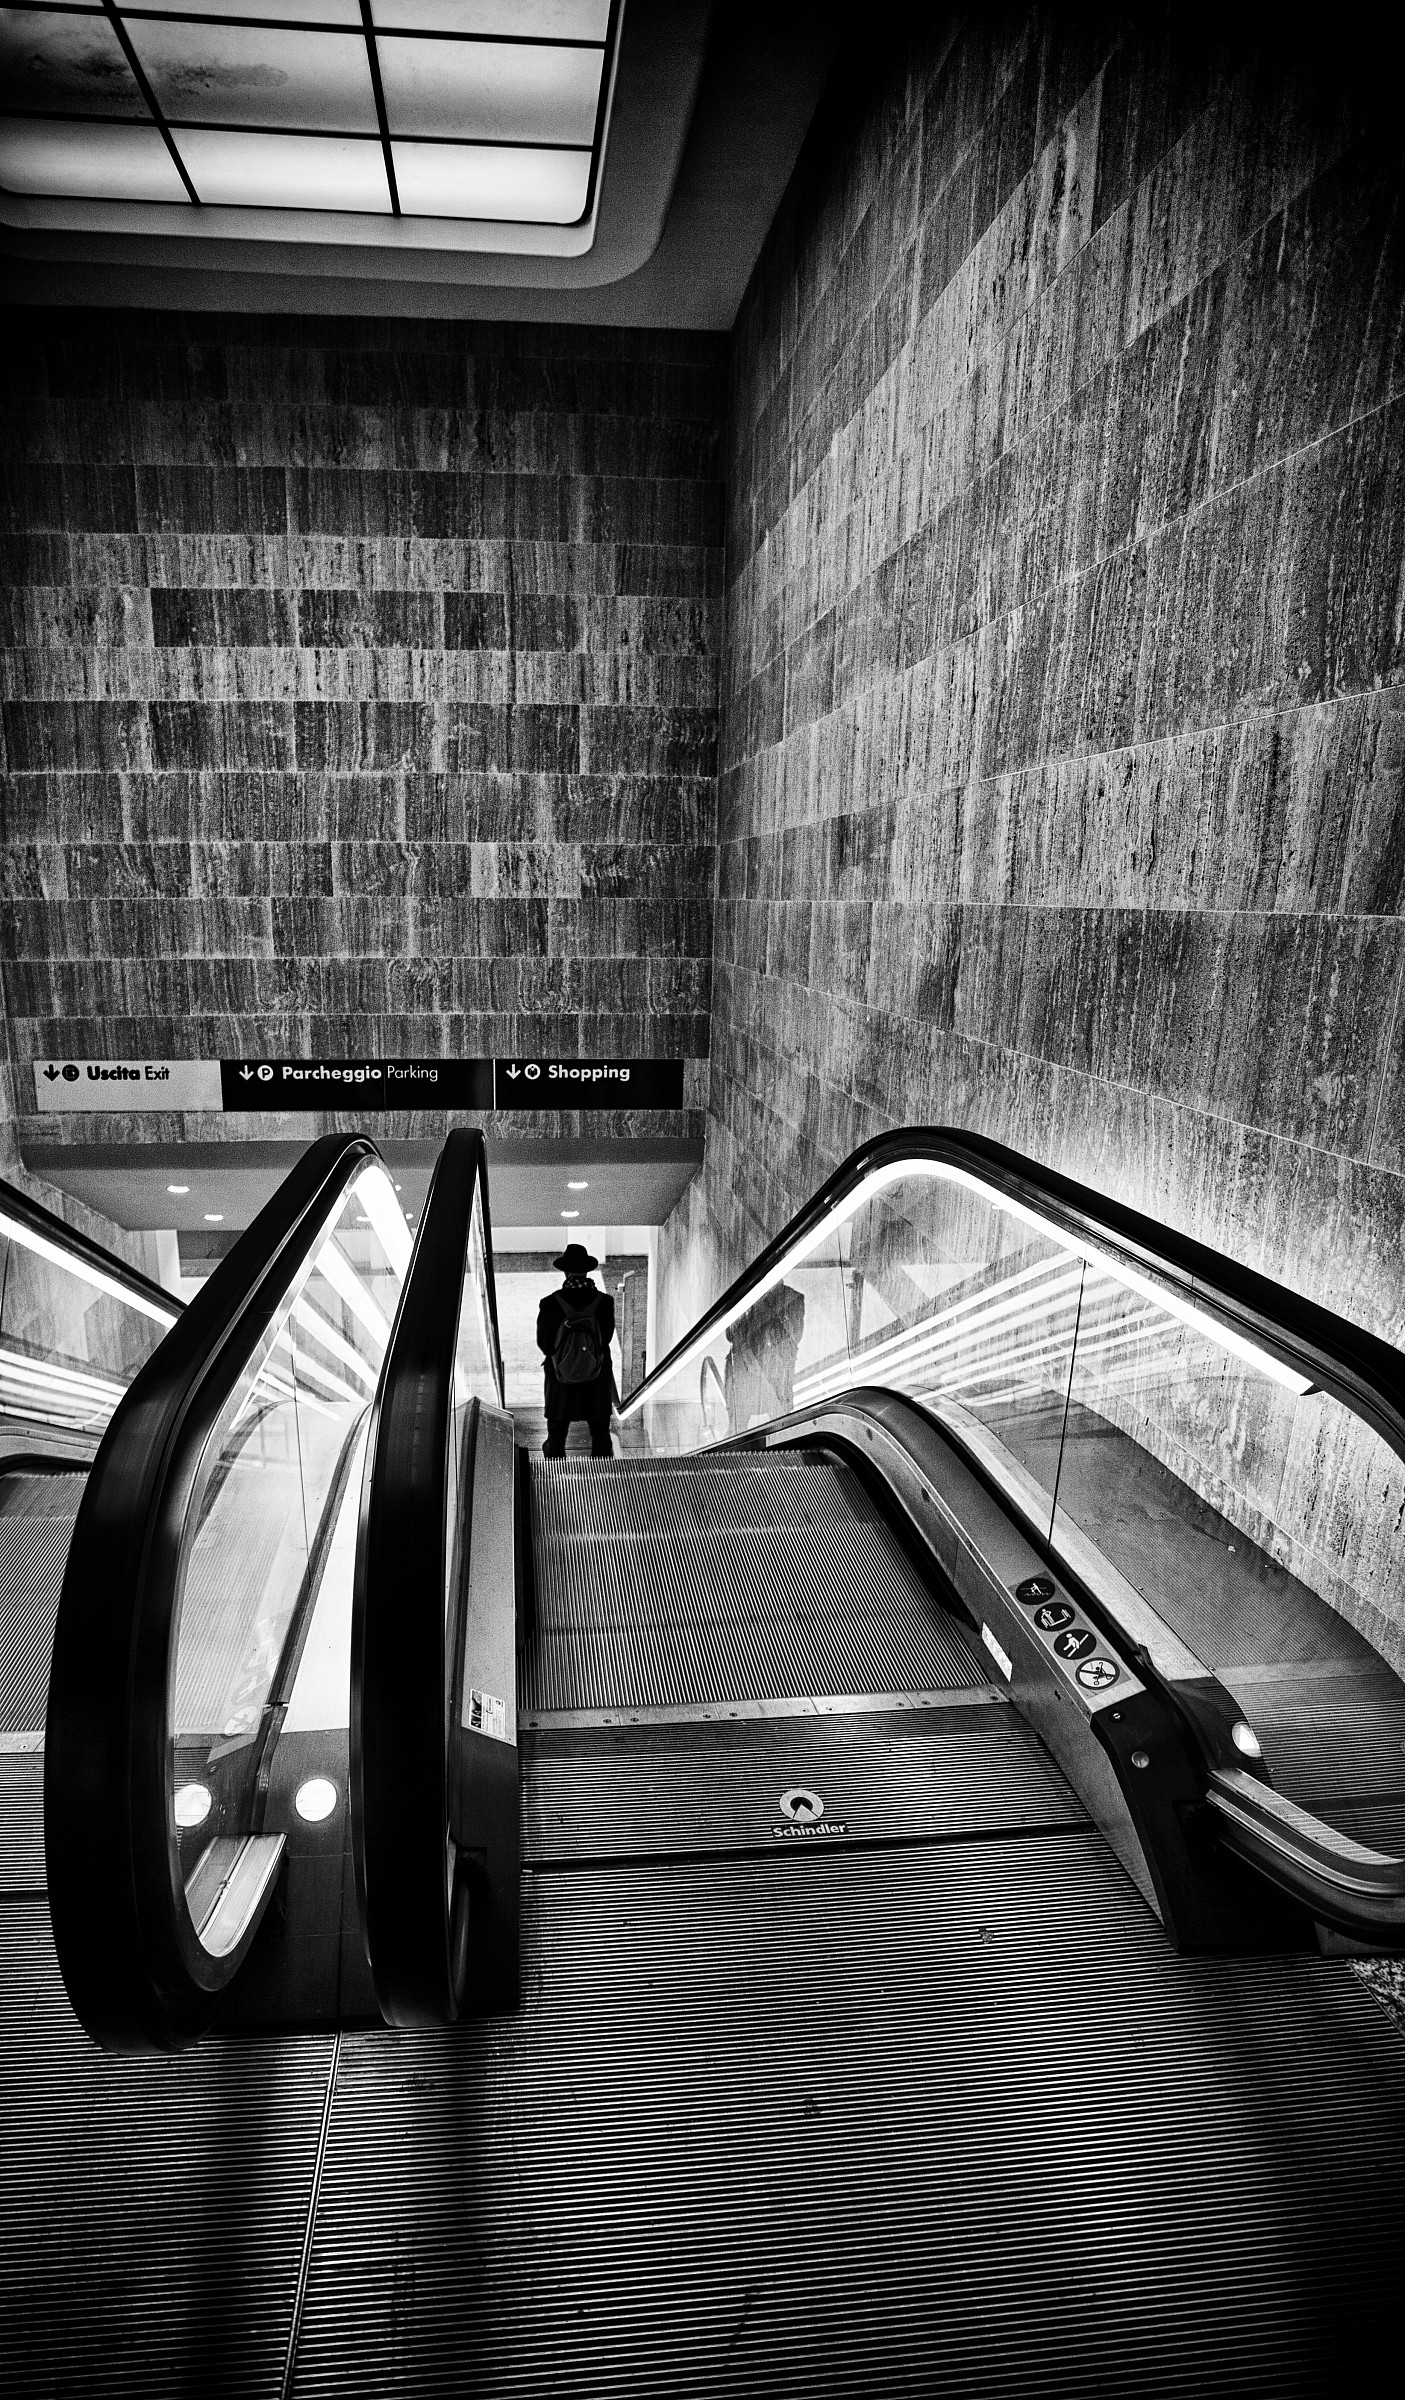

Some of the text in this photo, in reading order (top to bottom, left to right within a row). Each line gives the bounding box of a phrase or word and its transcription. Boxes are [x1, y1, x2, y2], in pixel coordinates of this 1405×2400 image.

[86, 1065, 170, 1081] Uscita Exit
[282, 1065, 382, 1083] Parcheggio
[387, 1065, 438, 1082] Parking
[548, 1065, 631, 1082] Shopping
[773, 1824, 846, 1838] Schindler
